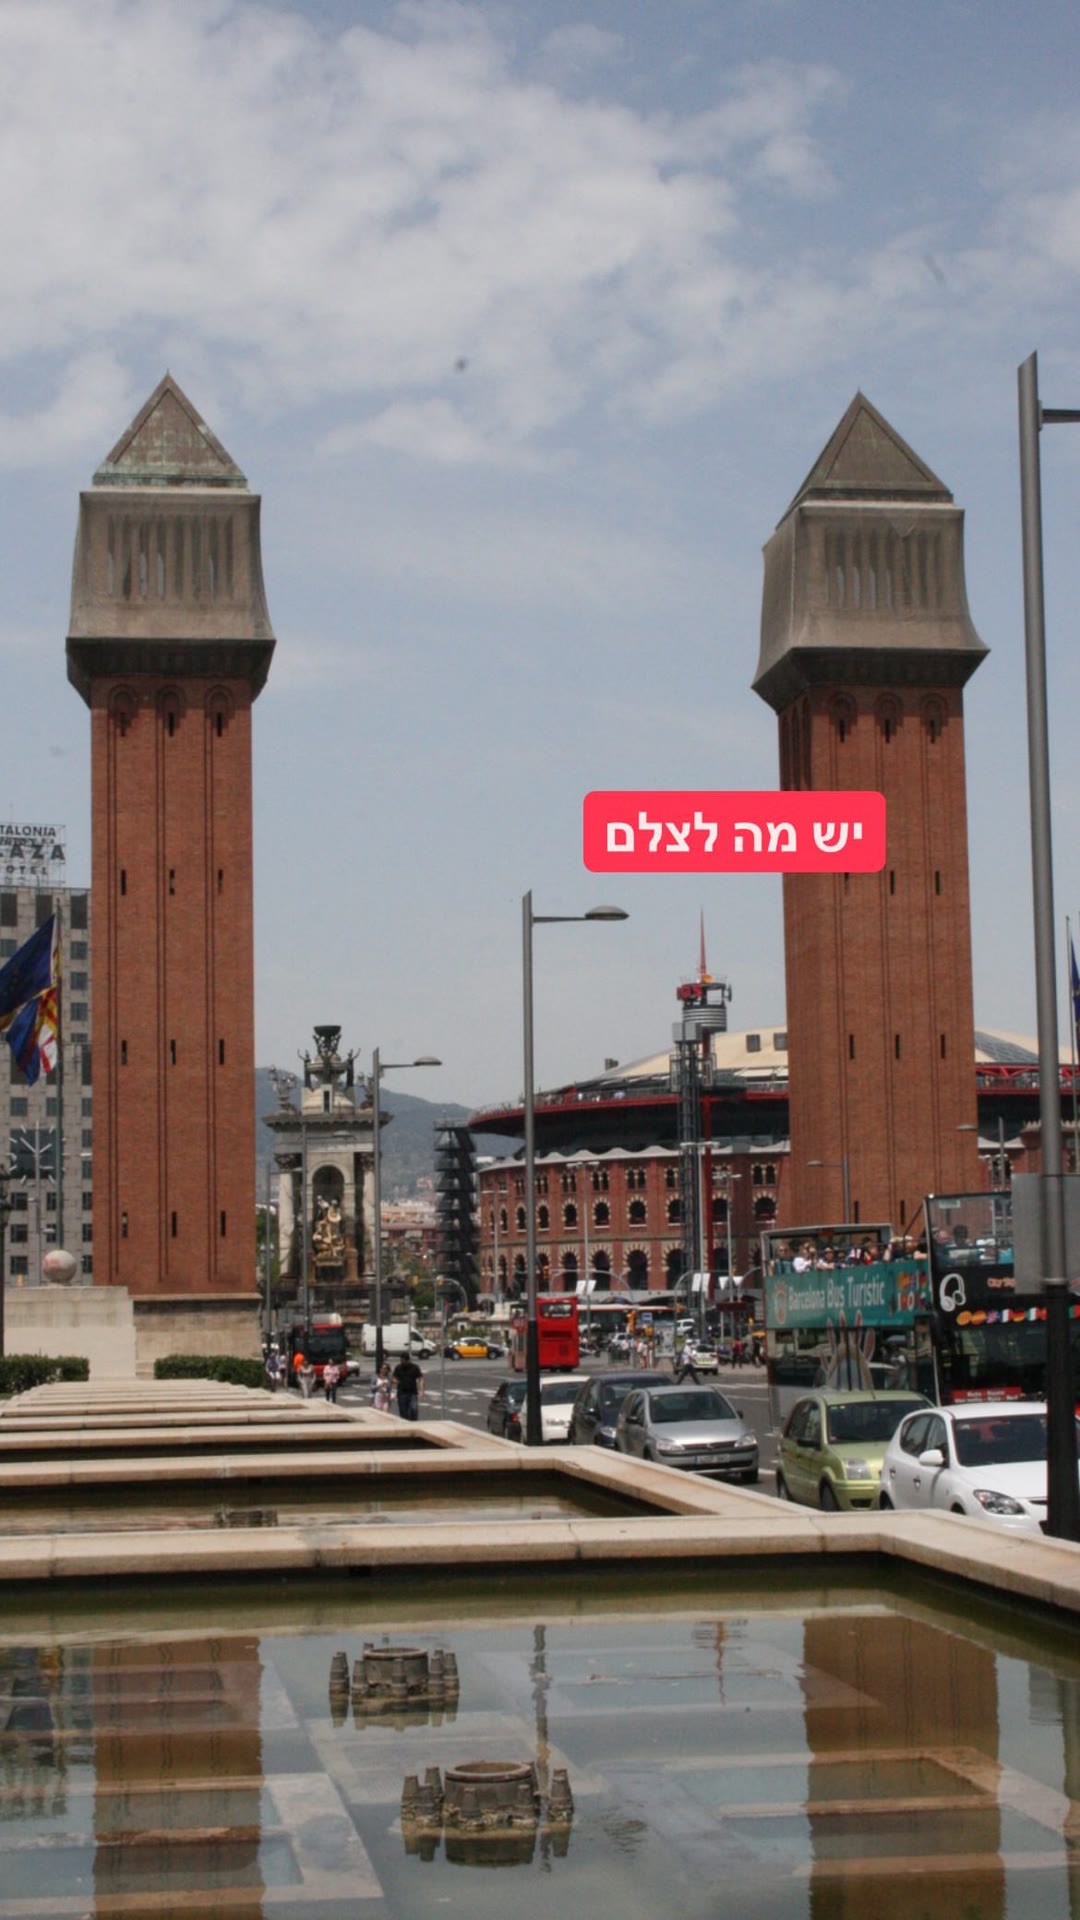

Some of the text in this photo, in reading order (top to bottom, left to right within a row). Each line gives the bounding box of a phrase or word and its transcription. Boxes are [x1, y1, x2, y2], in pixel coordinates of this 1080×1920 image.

[0, 845, 65, 860] AZA
[789, 1272, 885, 1310] Barcelona Bus Turístic
